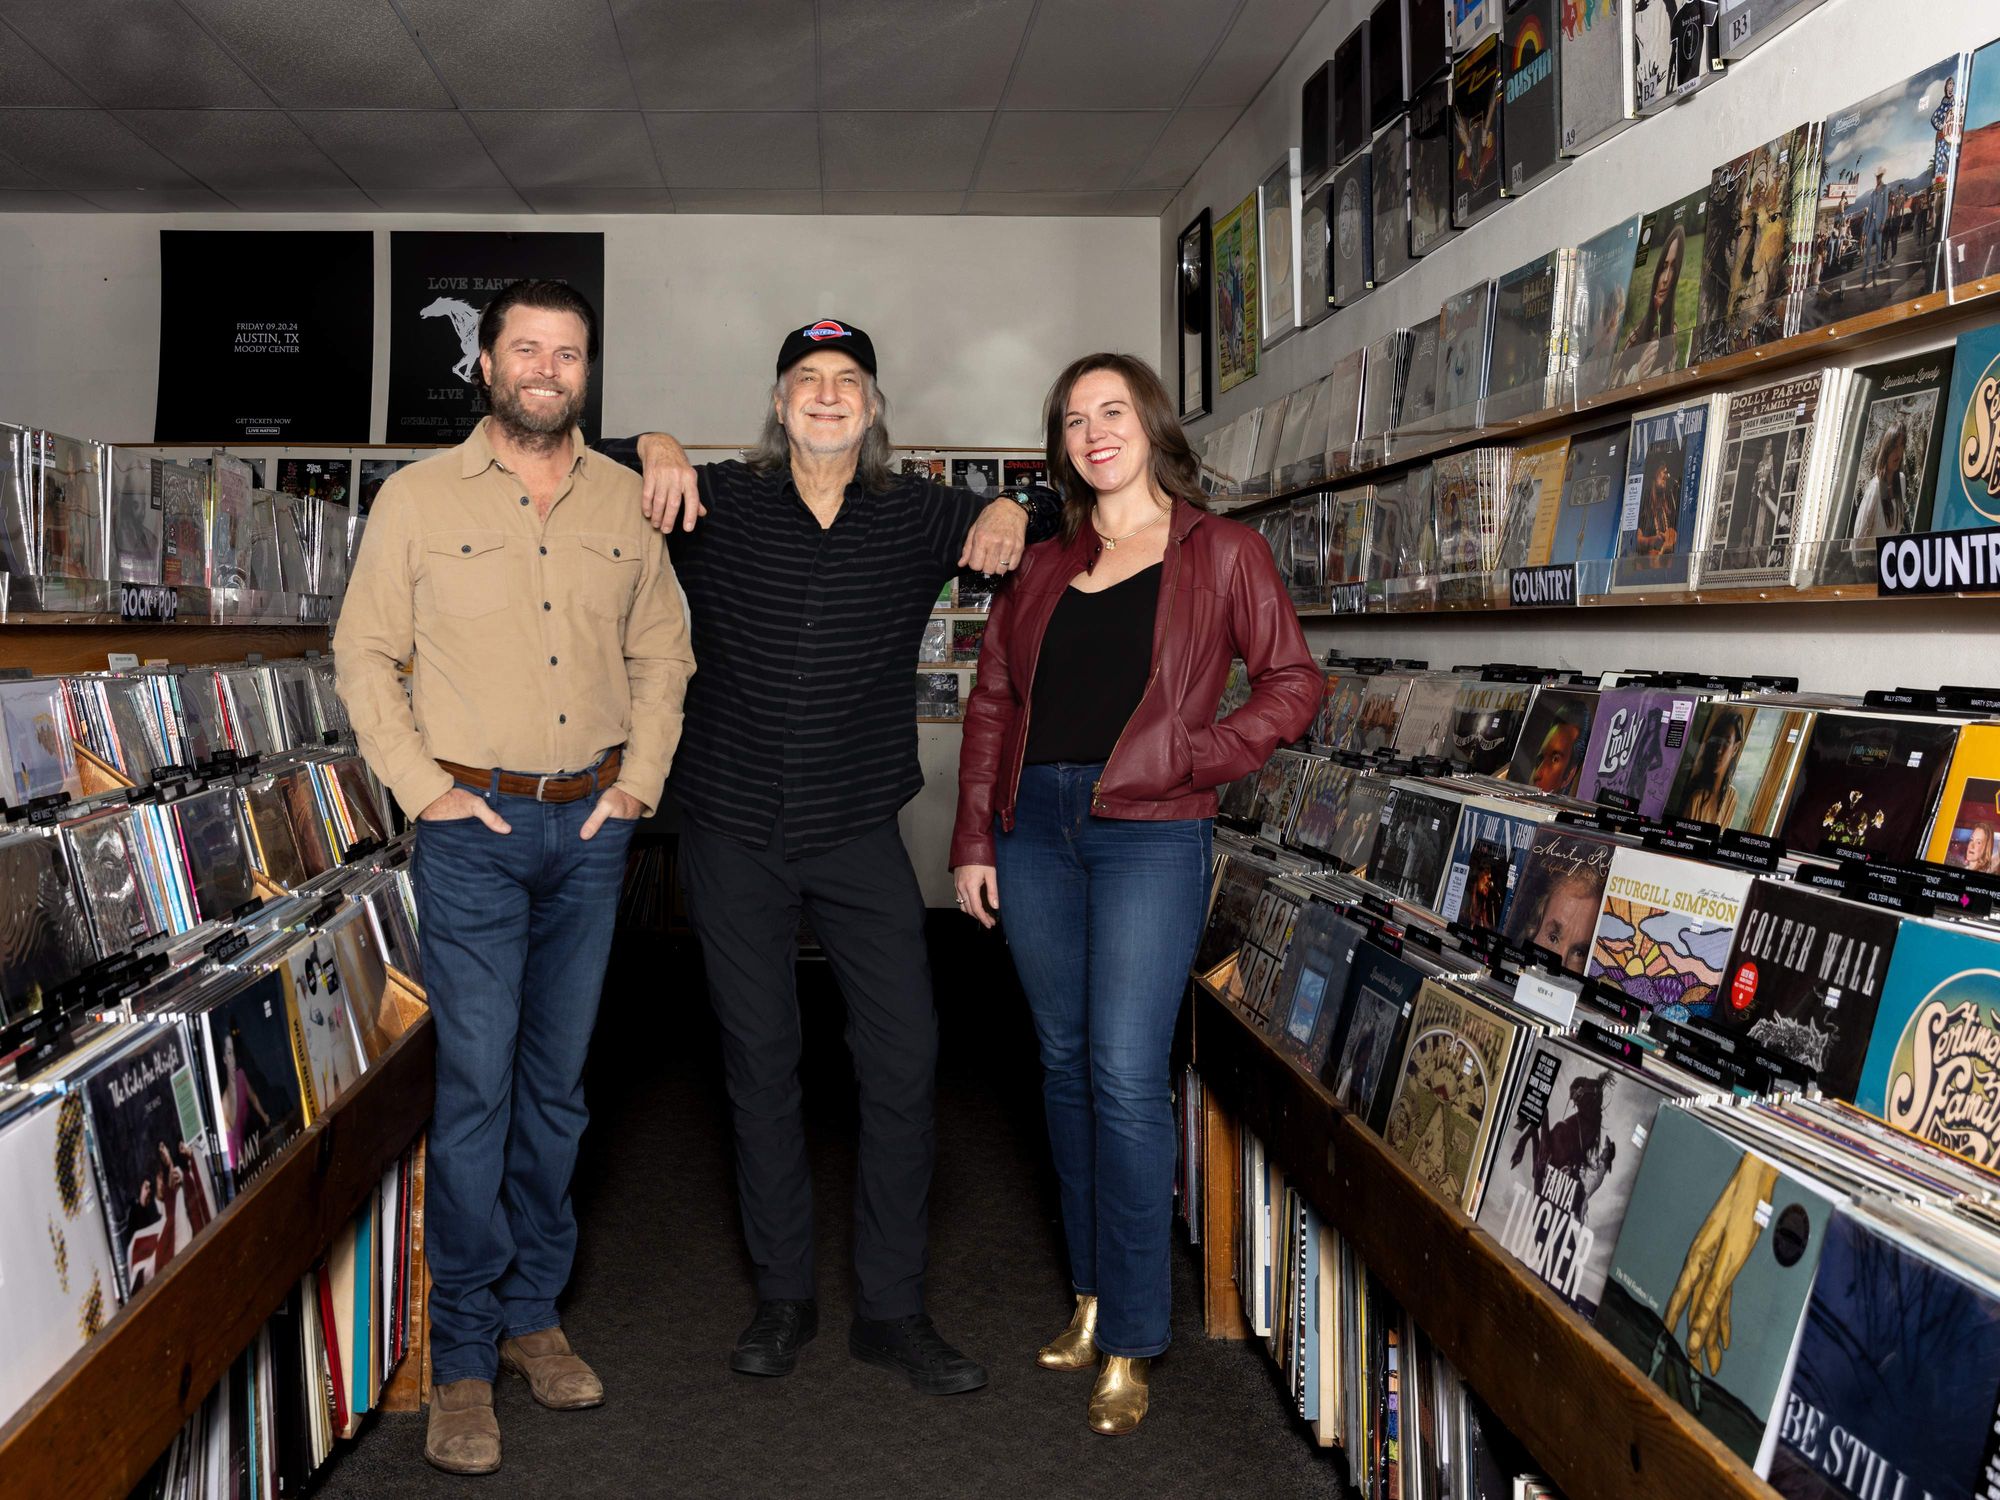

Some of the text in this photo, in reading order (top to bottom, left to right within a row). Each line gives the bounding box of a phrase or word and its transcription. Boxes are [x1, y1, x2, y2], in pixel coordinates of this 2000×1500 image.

[1732, 13, 1748, 42] B3
[1643, 81, 1655, 102] B2
[1565, 129, 1576, 147] A9
[1513, 166, 1522, 181] A8
[427, 276, 468, 291] LOVE
[472, 276, 524, 291] EART
[236, 322, 298, 331] FRIDAY 09.20.24
[234, 332, 300, 345] AUSTIN, TX
[233, 345, 300, 353] MOODY CENTER
[1880, 366, 1941, 391] Louisiana Lonely
[427, 388, 464, 400] LIVE
[1731, 378, 1822, 411] DOLLY PARTON
[1752, 397, 1793, 415] & FAMILY
[1743, 410, 1796, 430] SMOKY MOUNTAIN DNA
[1512, 568, 1573, 602] COUNTRY
[121, 588, 151, 616] ROCK
[158, 590, 178, 617] POP
[1597, 707, 1646, 775] Emily
[1853, 744, 1889, 759] Billy Strings
[1461, 809, 1501, 853] WILLIE
[1675, 820, 1690, 830] DARIUS
[1689, 822, 1702, 832] RUCKER
[1660, 838, 1694, 850] STURGILL SIMPSON
[1739, 835, 1771, 848] CHRIS STAPLETON
[1532, 836, 1587, 877] Marty
[1716, 847, 1730, 857] SHANE
[1729, 849, 1742, 859] SMITH
[1745, 853, 1753, 862] THE
[1752, 854, 1768, 865] SAINTS
[1836, 847, 1867, 861] GEORGE STRAIT
[1812, 875, 1833, 887] MORGAN
[1609, 875, 1739, 923] STURGILL SIMPSON
[1868, 891, 1902, 907] COLTER WALL
[1922, 888, 1959, 903] DALE WATSON
[1739, 908, 1881, 997] COLTER WALL
[1607, 1037, 1623, 1050] TUCKER
[1676, 1050, 1722, 1081] TURNPIKE TROUBADOURS
[1755, 1055, 1783, 1075] KEITH URBAN
[122, 1067, 144, 1099] Kids
[236, 1129, 261, 1175] AMY
[1541, 1162, 1580, 1210] TANYA
[1500, 1180, 1595, 1301] TUCKER
[1615, 1266, 1624, 1280] The
[1779, 1391, 1825, 1461] BE
